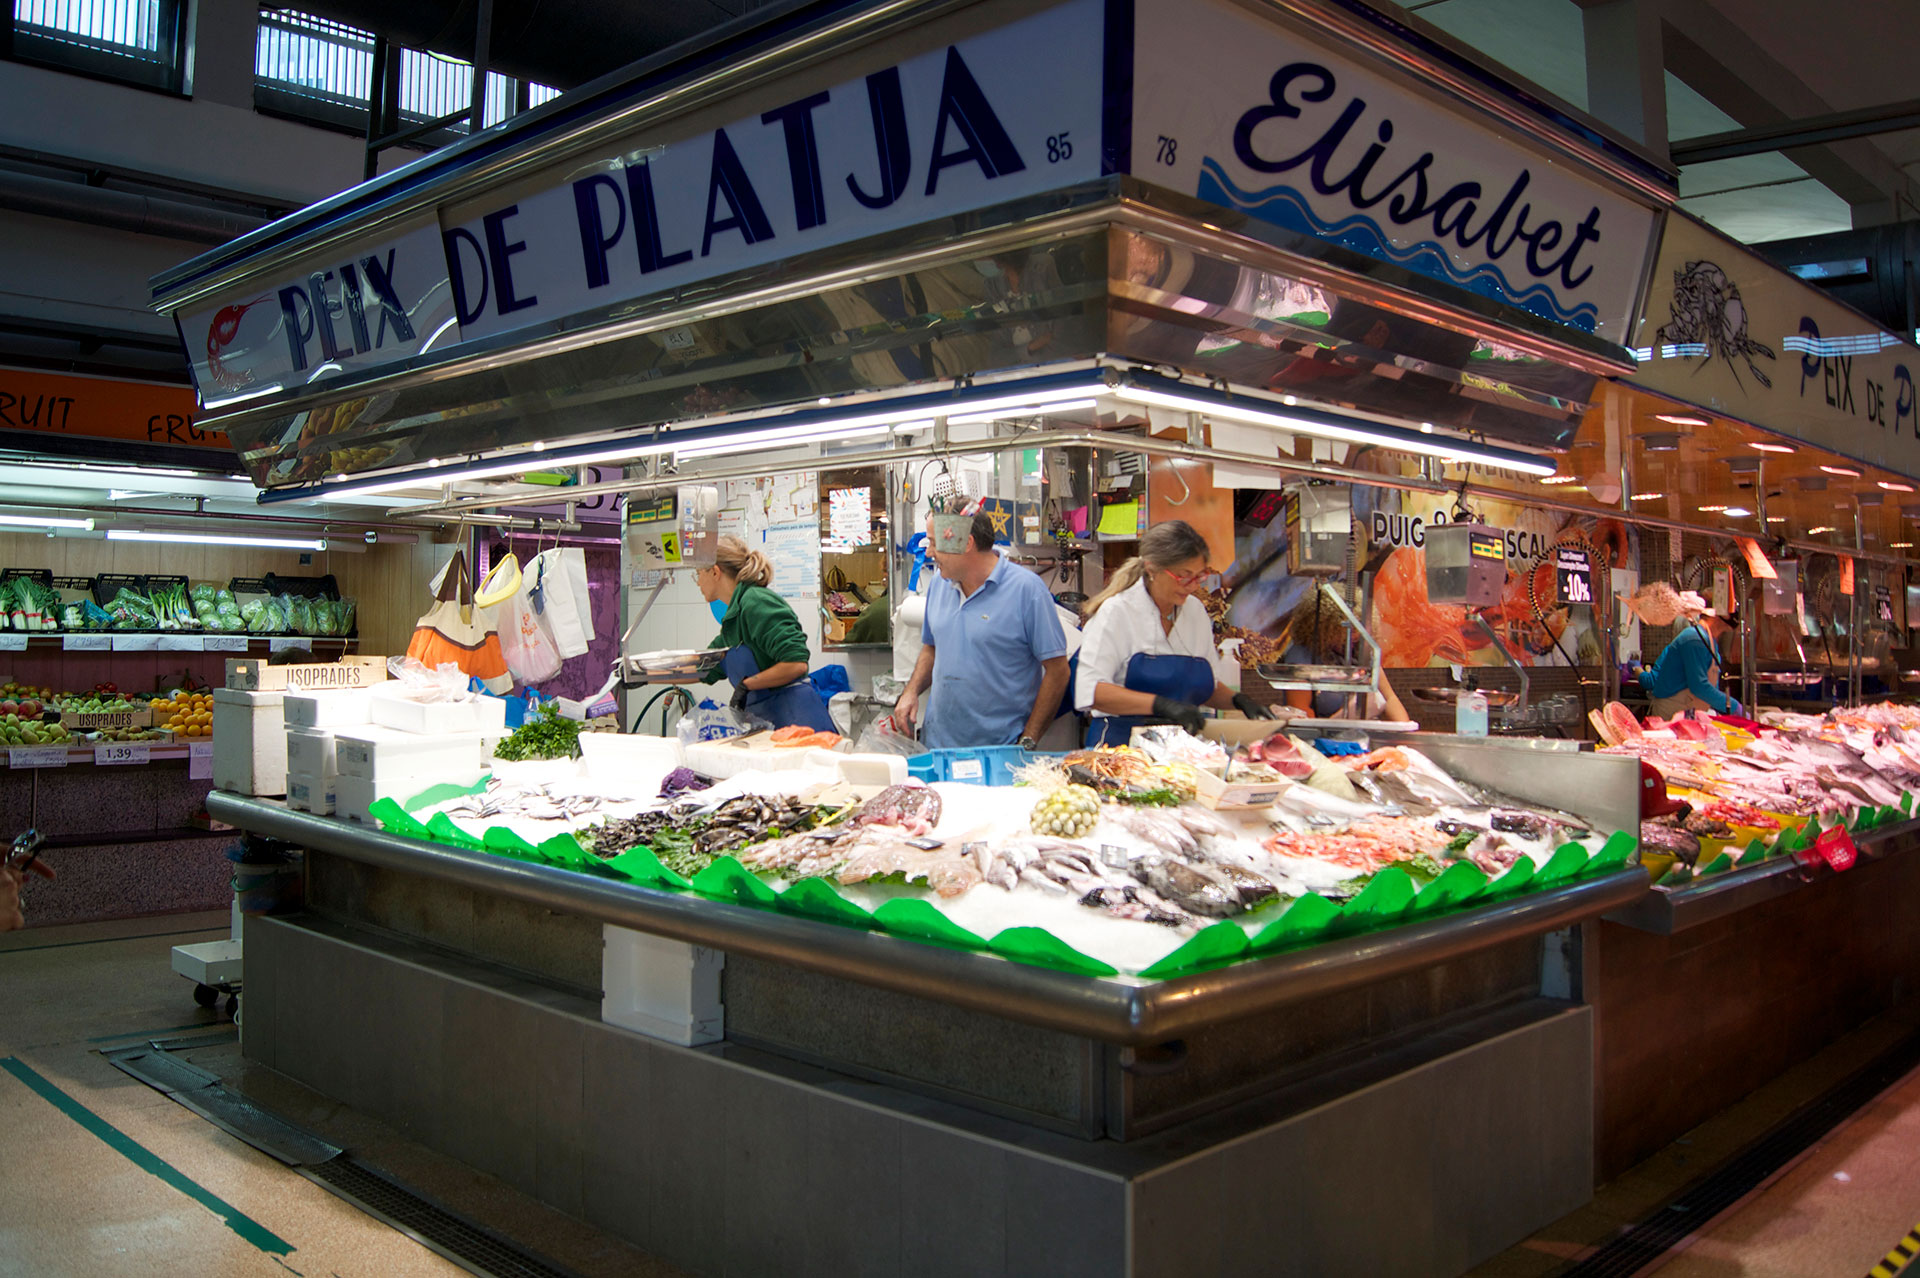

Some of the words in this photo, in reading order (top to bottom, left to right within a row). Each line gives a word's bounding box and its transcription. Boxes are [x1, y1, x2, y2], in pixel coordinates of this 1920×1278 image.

[1046, 131, 1073, 164] 85
[1157, 134, 1177, 166] 78
[1233, 62, 1601, 290] Elisabet
[278, 247, 417, 373] PEIX
[442, 204, 538, 328] DE
[572, 44, 1027, 290] PLATJA
[1866, 378, 1886, 428] DE
[1373, 511, 1425, 549] PUIG
[1563, 573, 1591, 602] -10%
[286, 666, 361, 687] USOPRADES
[79, 712, 133, 727] USOPRADES
[105, 747, 132, 760] 1,39
